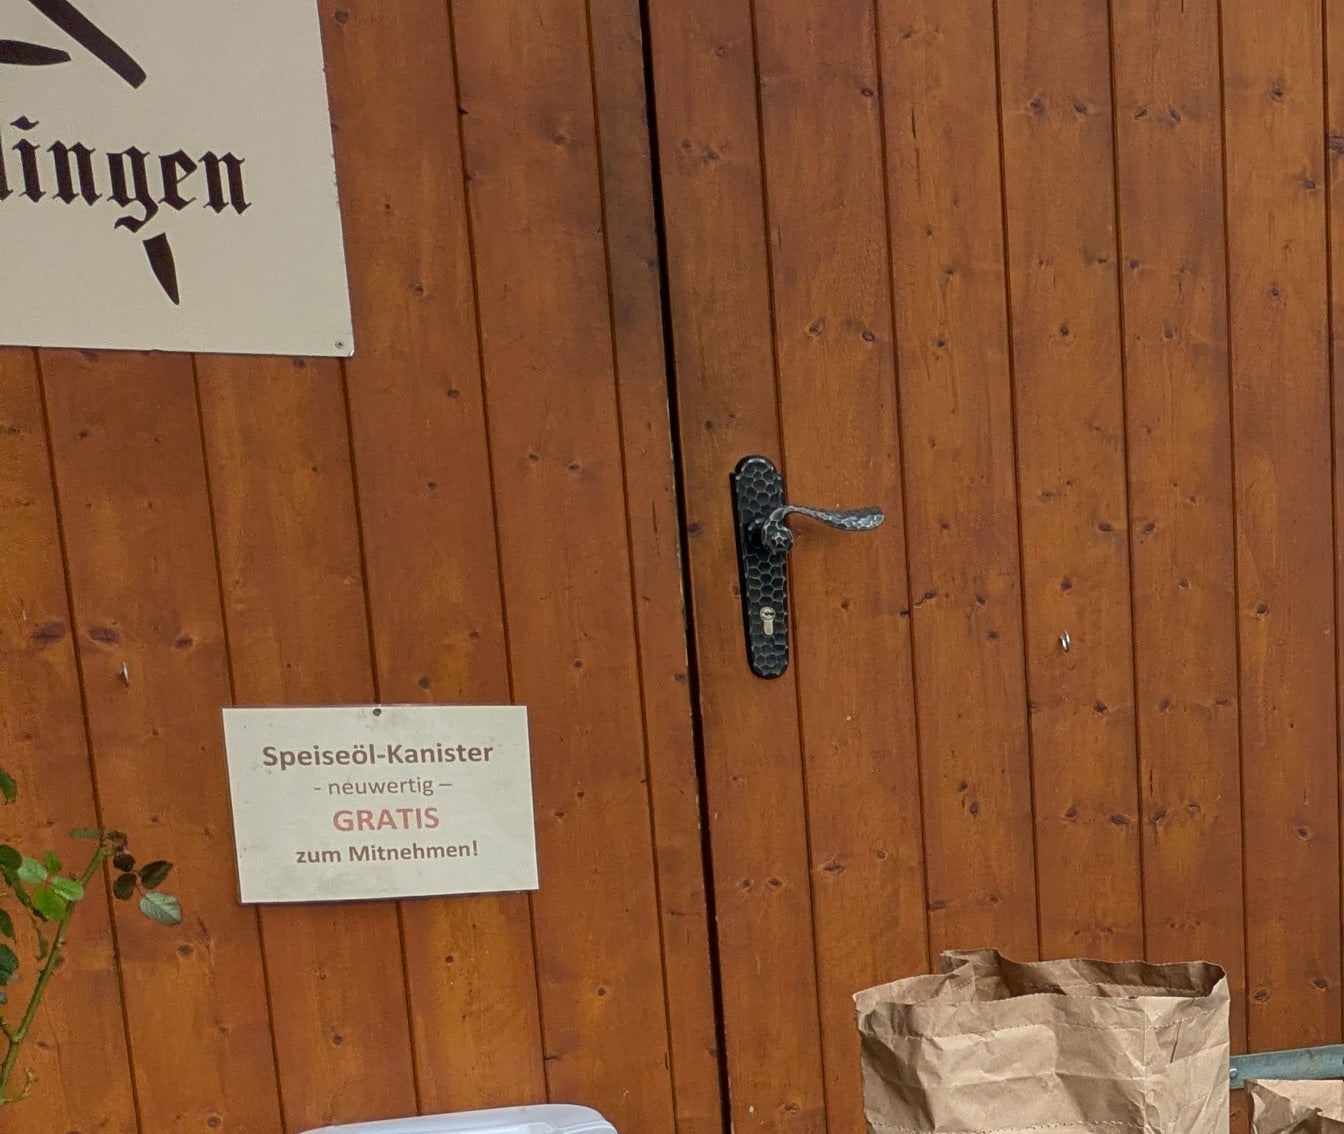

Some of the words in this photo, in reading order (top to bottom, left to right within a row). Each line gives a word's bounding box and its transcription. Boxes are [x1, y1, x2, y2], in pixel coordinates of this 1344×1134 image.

[262, 743, 494, 771] Speiseöl-Kanister
[328, 777, 434, 797] neuwertig
[332, 807, 440, 832] GRATIS
[296, 847, 342, 864] zum
[348, 840, 479, 862] Mitnehmen!
